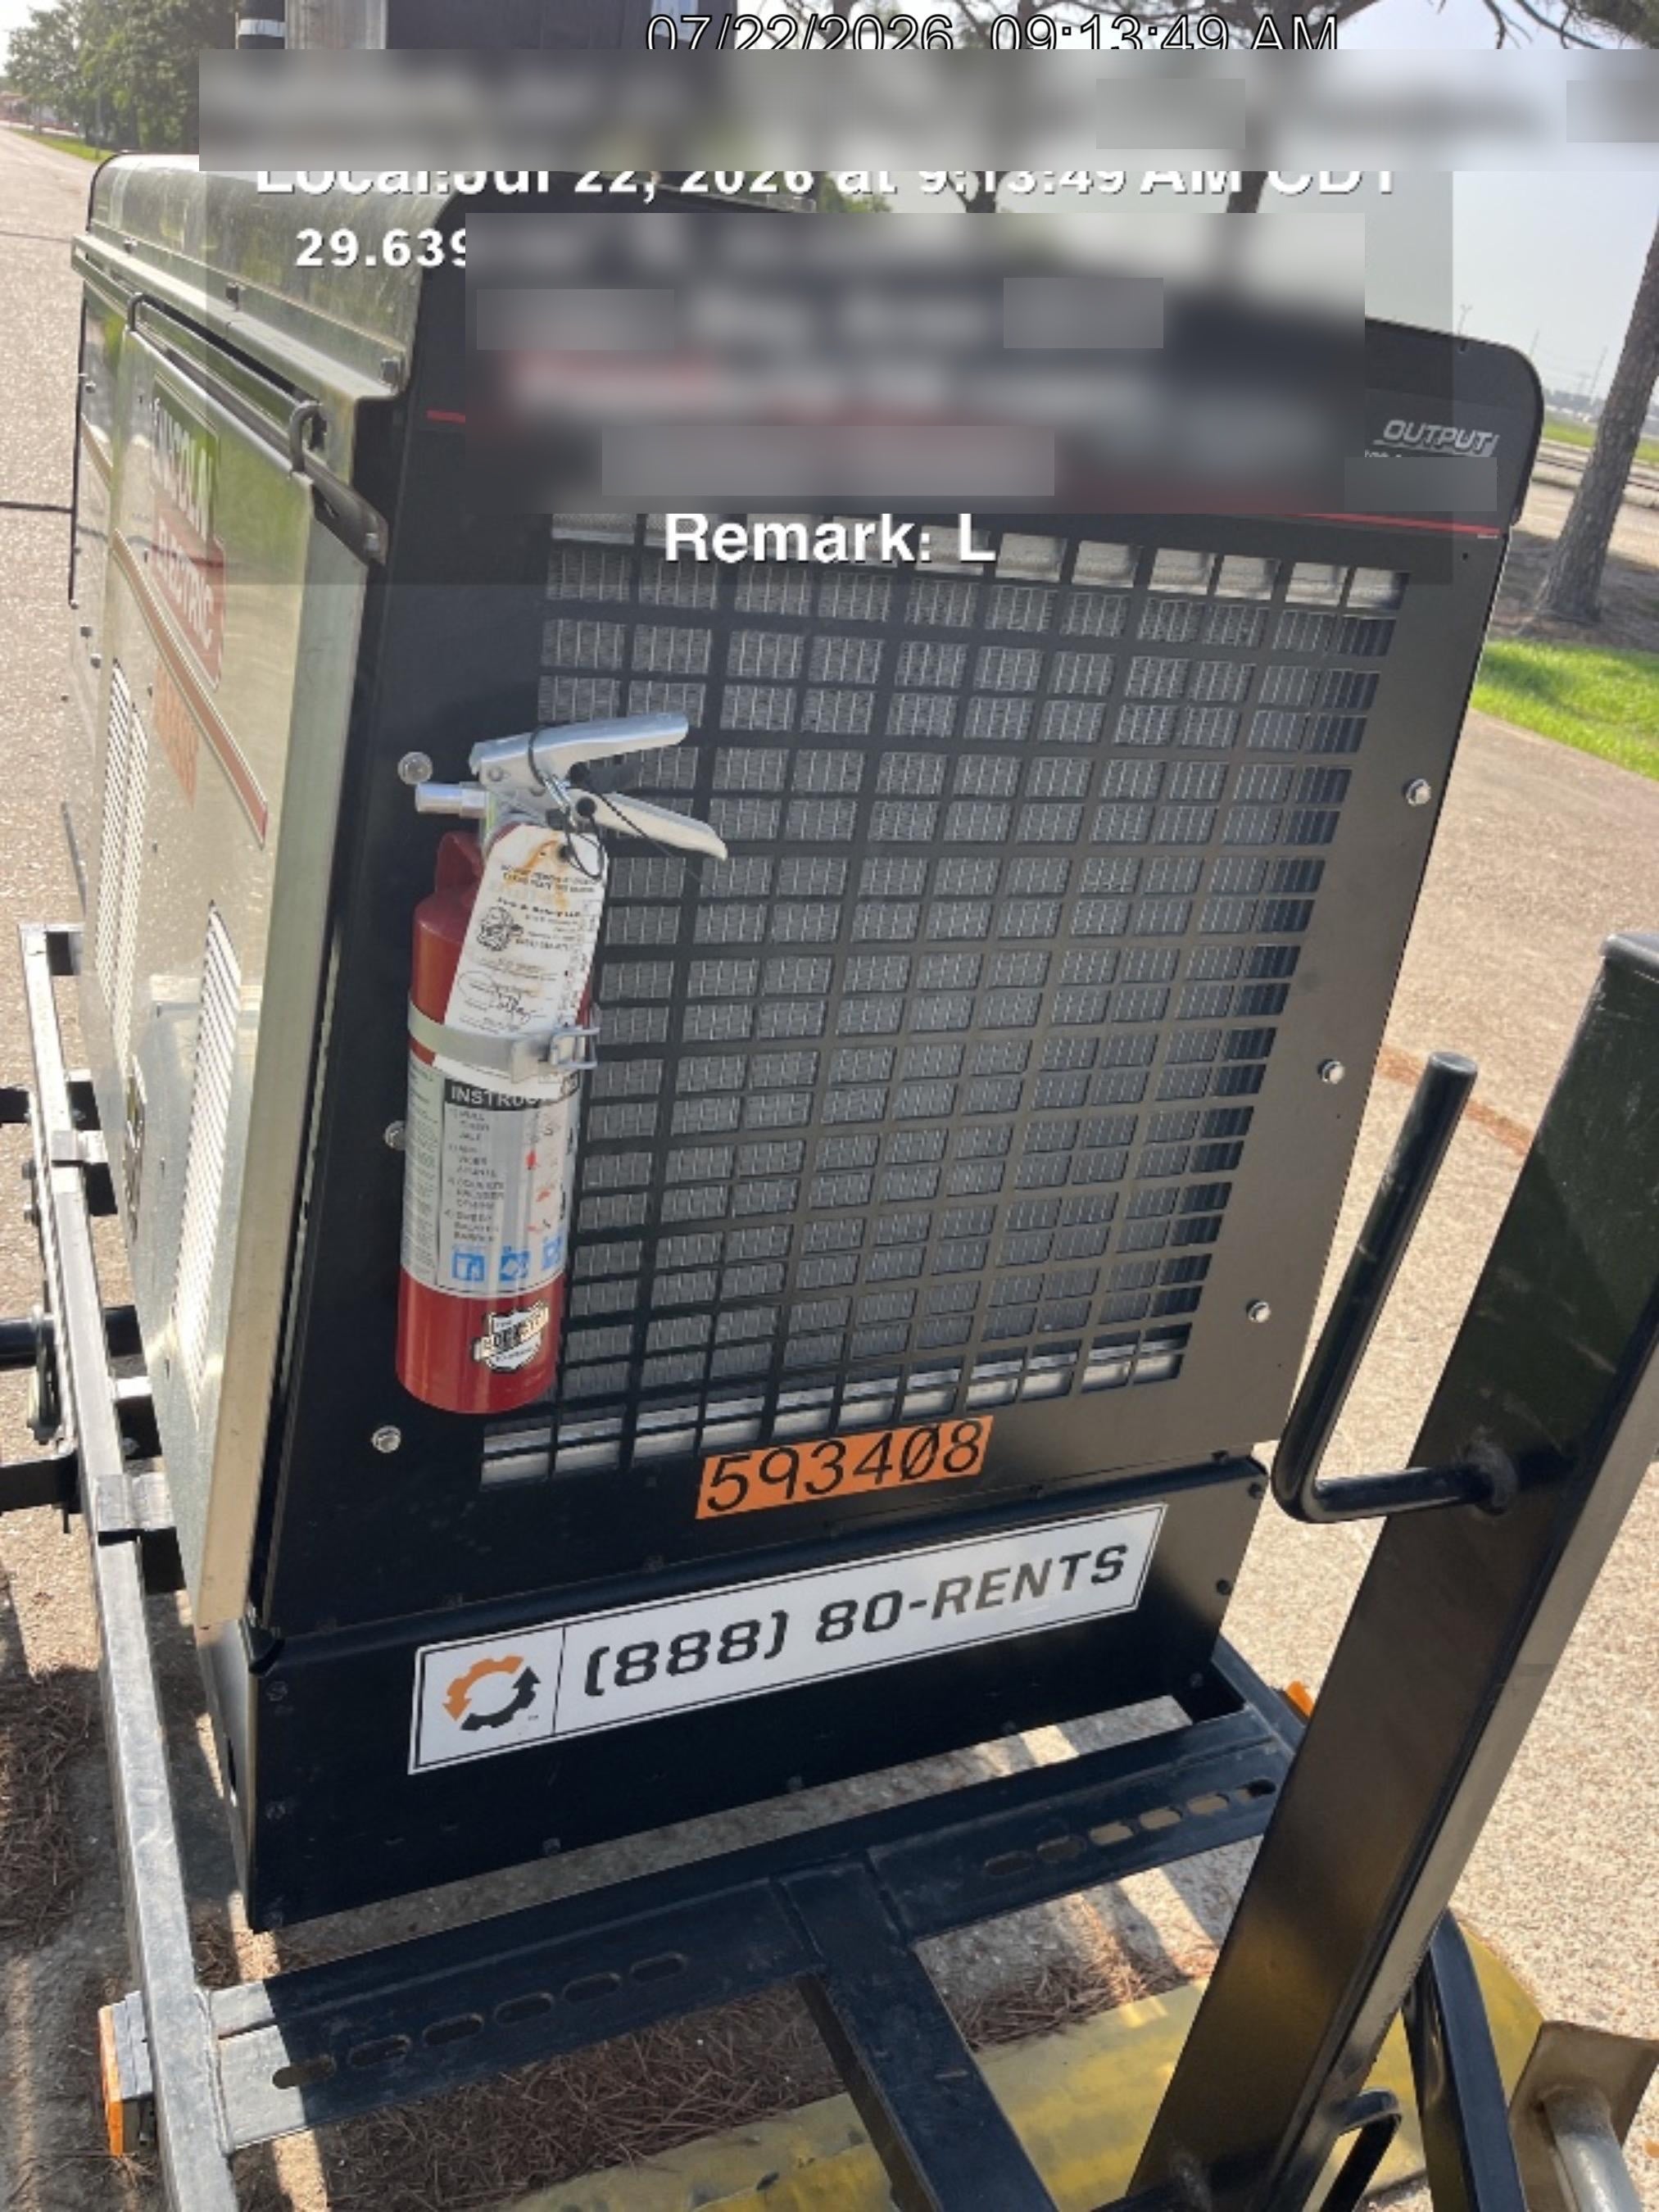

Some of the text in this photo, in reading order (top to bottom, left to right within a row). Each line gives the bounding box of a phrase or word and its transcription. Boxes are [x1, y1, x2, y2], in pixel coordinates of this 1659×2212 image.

[1382, 419, 1492, 451] OUTPUT
[706, 1419, 985, 1512] 593408
[584, 1543, 1128, 1697] (888) 80-RENTS
